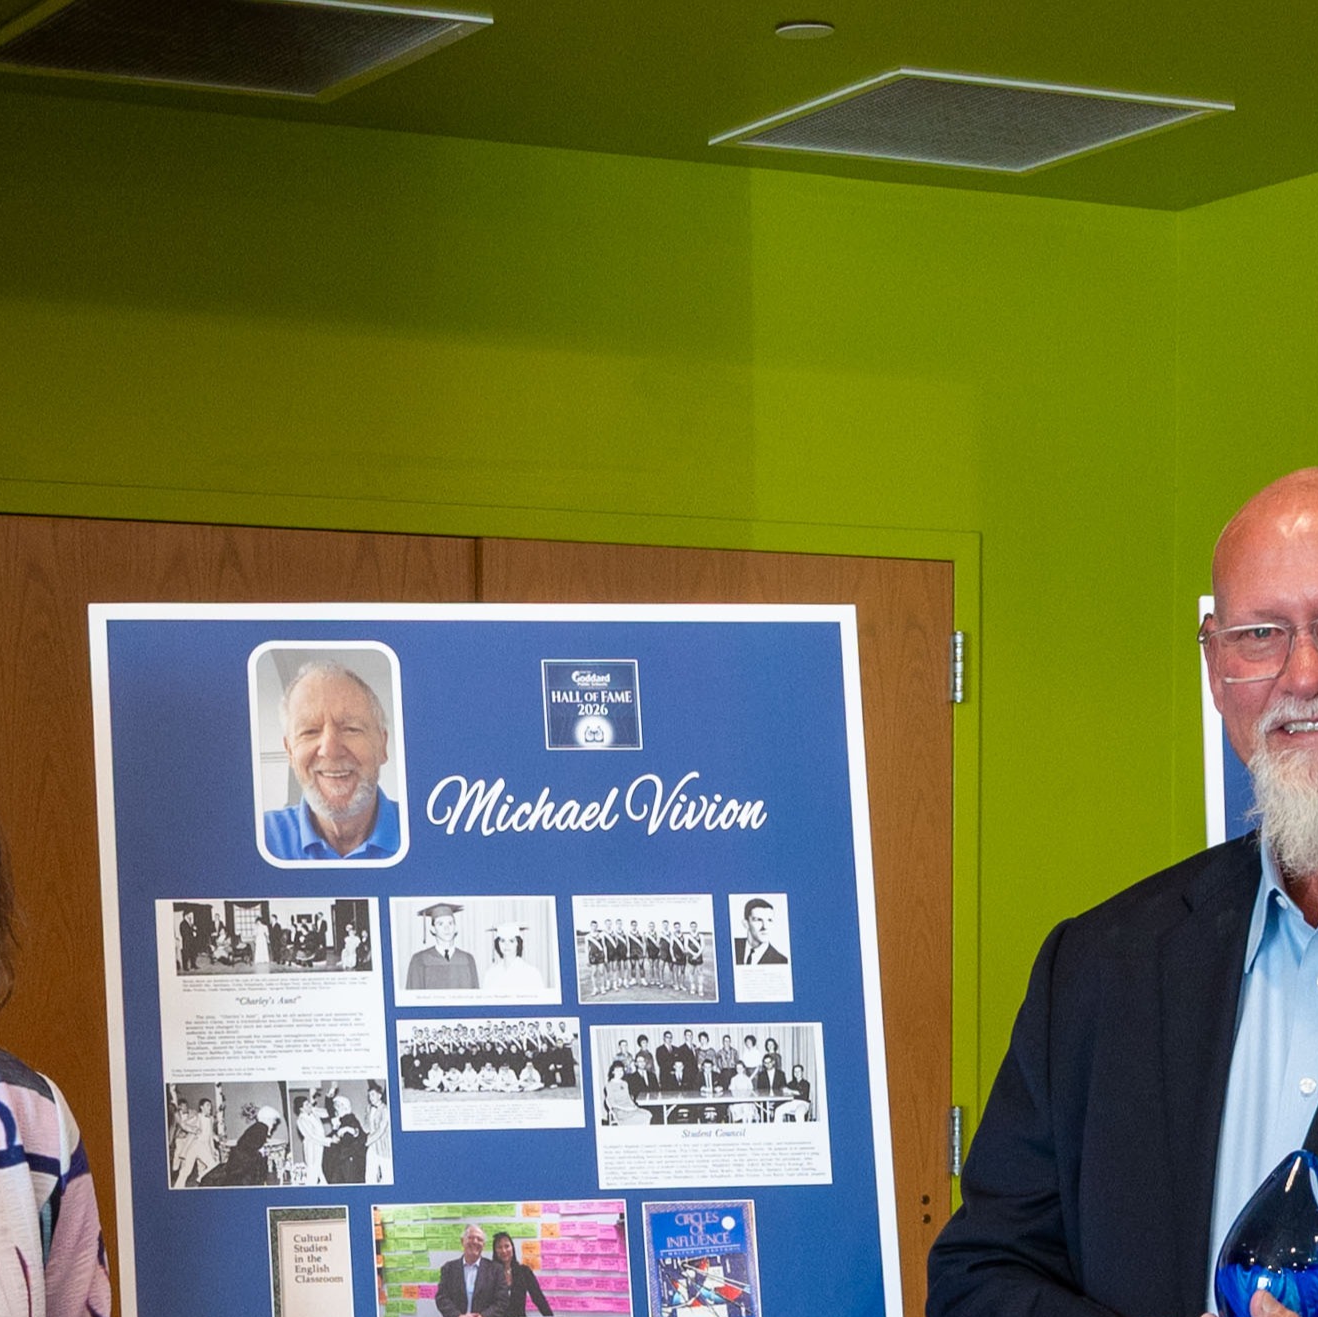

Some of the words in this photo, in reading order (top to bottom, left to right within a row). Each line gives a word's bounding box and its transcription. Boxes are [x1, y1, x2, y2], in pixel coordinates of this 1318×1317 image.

[571, 671, 611, 683] Goddard
[551, 690, 583, 703] HALL
[584, 692, 599, 702] OF
[600, 690, 633, 703] FAME
[577, 704, 609, 716] 2026
[426, 775, 620, 837] Michael
[625, 771, 768, 837] Vivion
[682, 1129, 712, 1139] Student
[715, 1128, 746, 1138] Council
[293, 1233, 332, 1243] Cultural
[666, 1232, 732, 1248] INFLUENCE
[293, 1244, 328, 1253] Studies
[294, 1254, 304, 1263] in
[307, 1254, 322, 1263] the
[295, 1264, 330, 1275] English
[295, 1275, 343, 1284] Classroom
